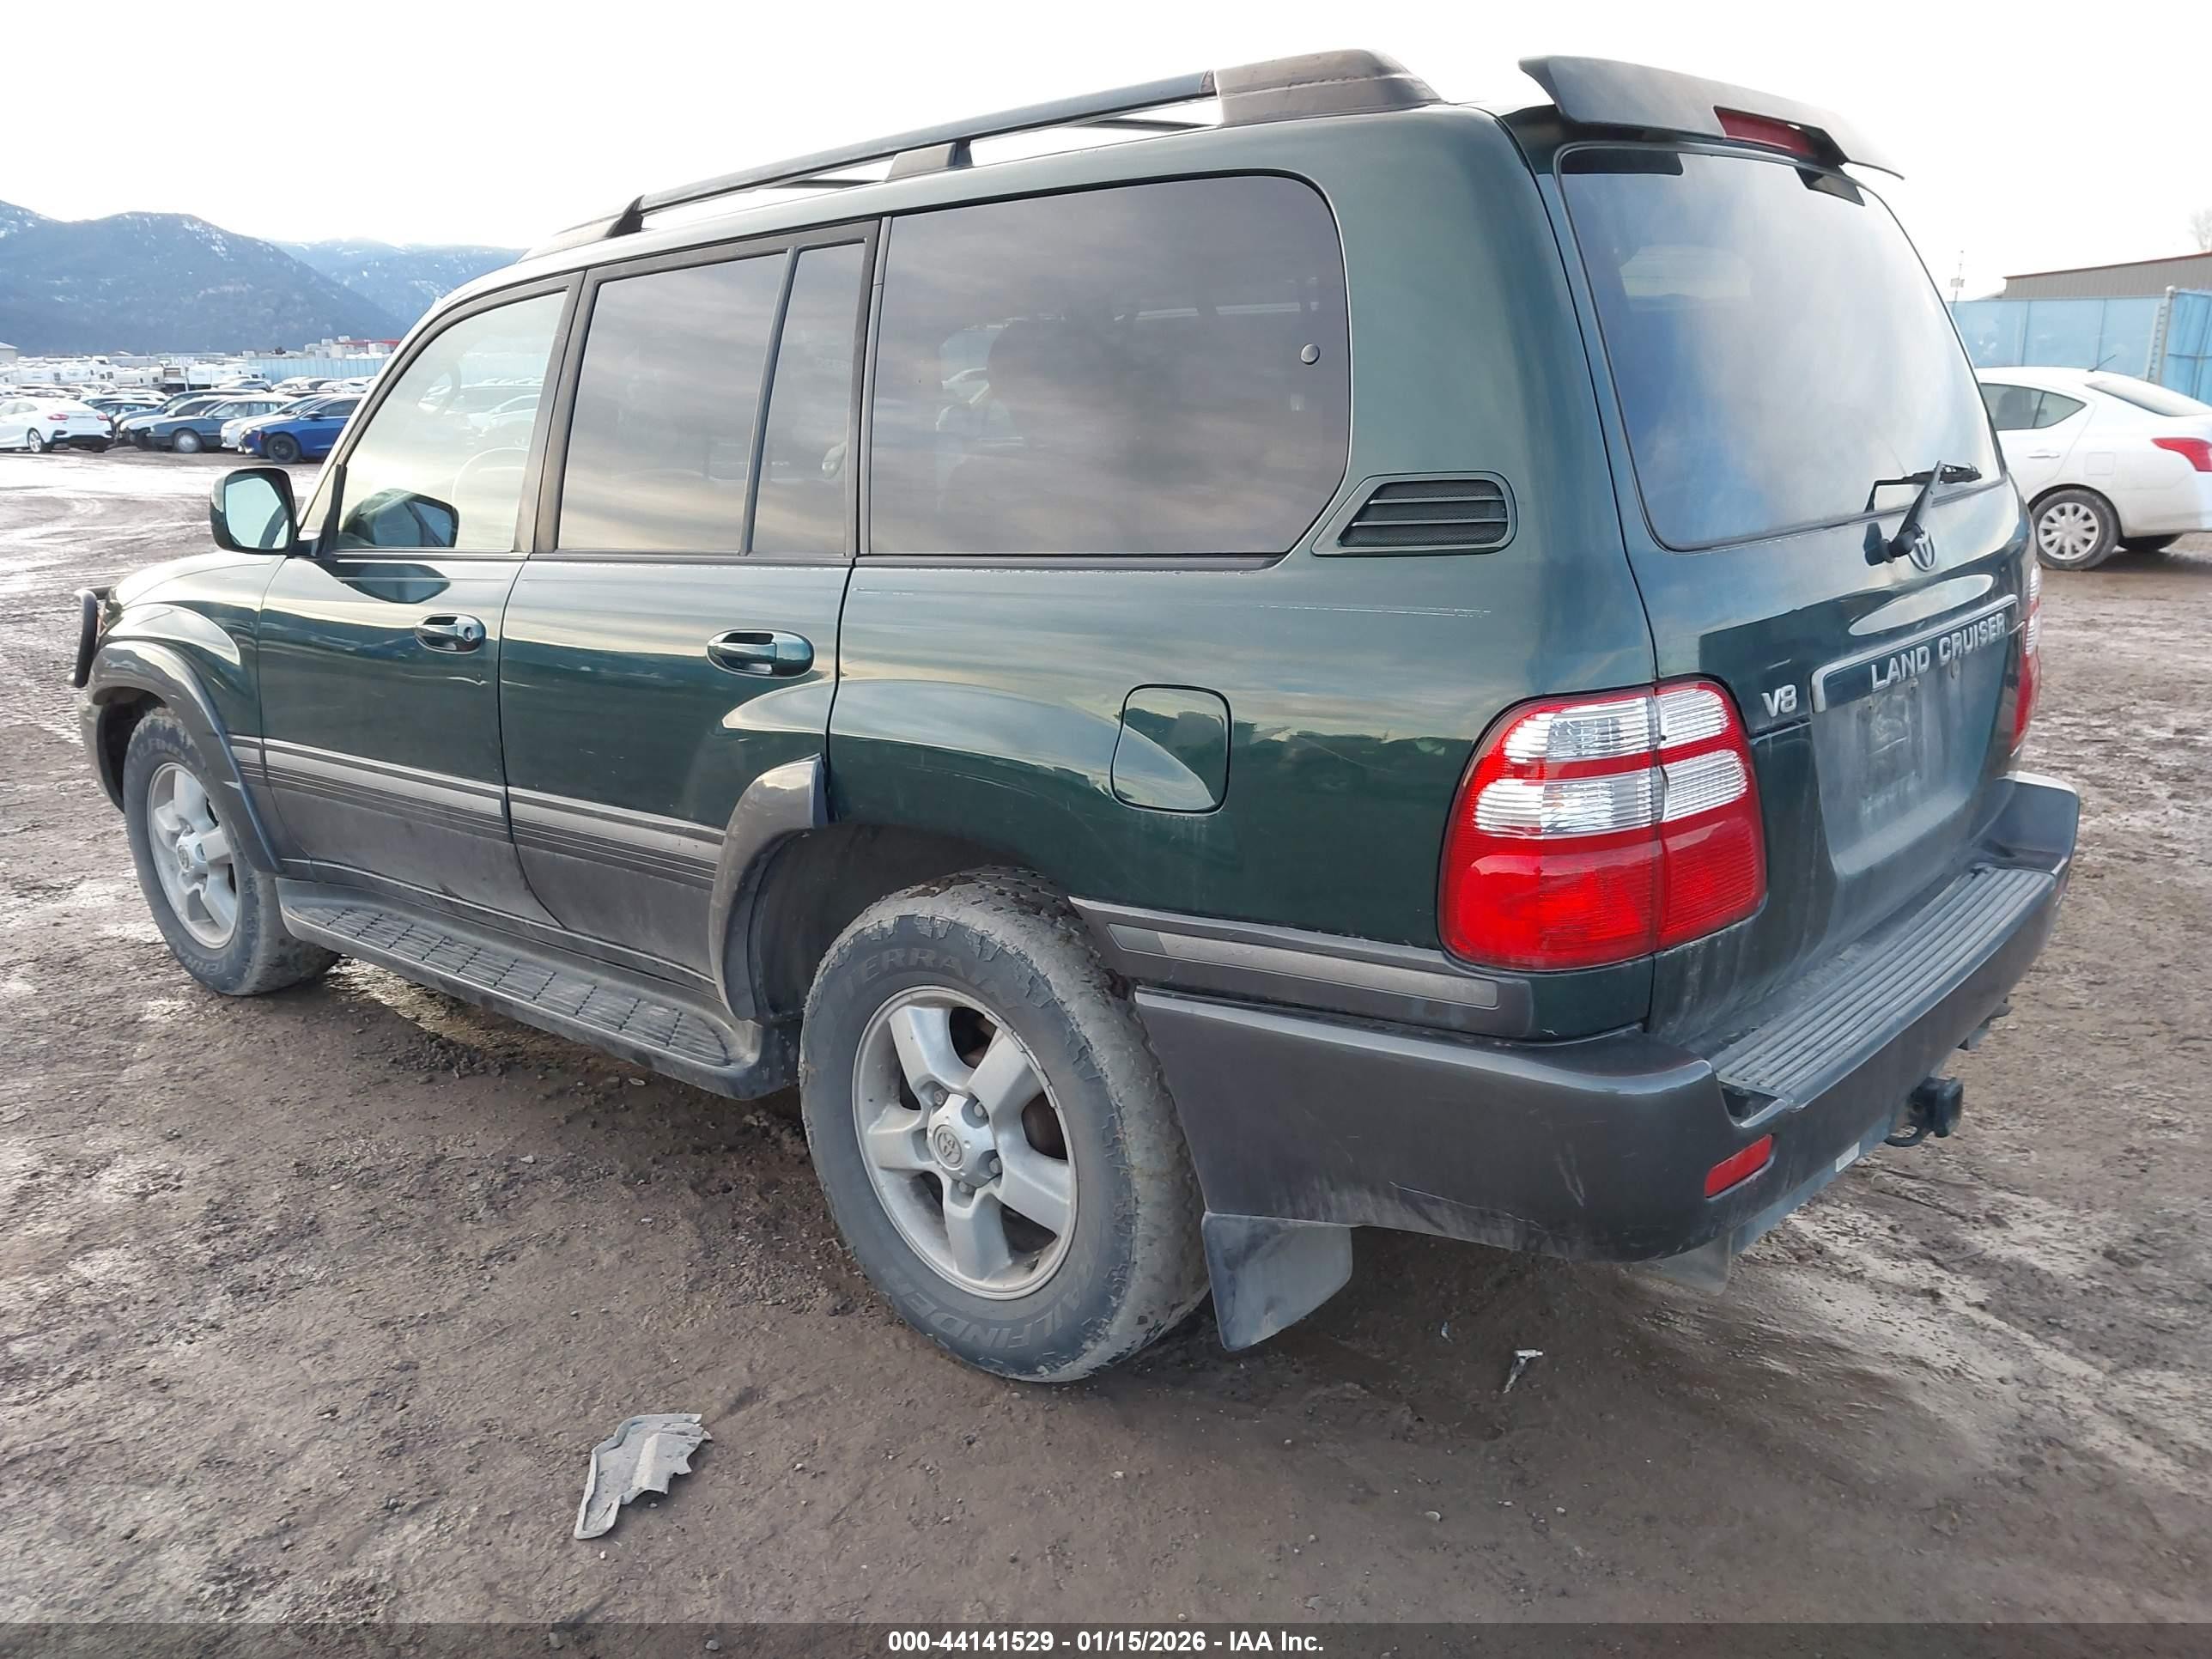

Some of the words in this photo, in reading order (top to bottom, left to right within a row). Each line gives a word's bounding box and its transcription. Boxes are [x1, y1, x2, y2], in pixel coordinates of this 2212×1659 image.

[1871, 647, 1930, 690] LAND
[1938, 612, 2007, 663] CRUISER
[1761, 684, 1798, 717] V8
